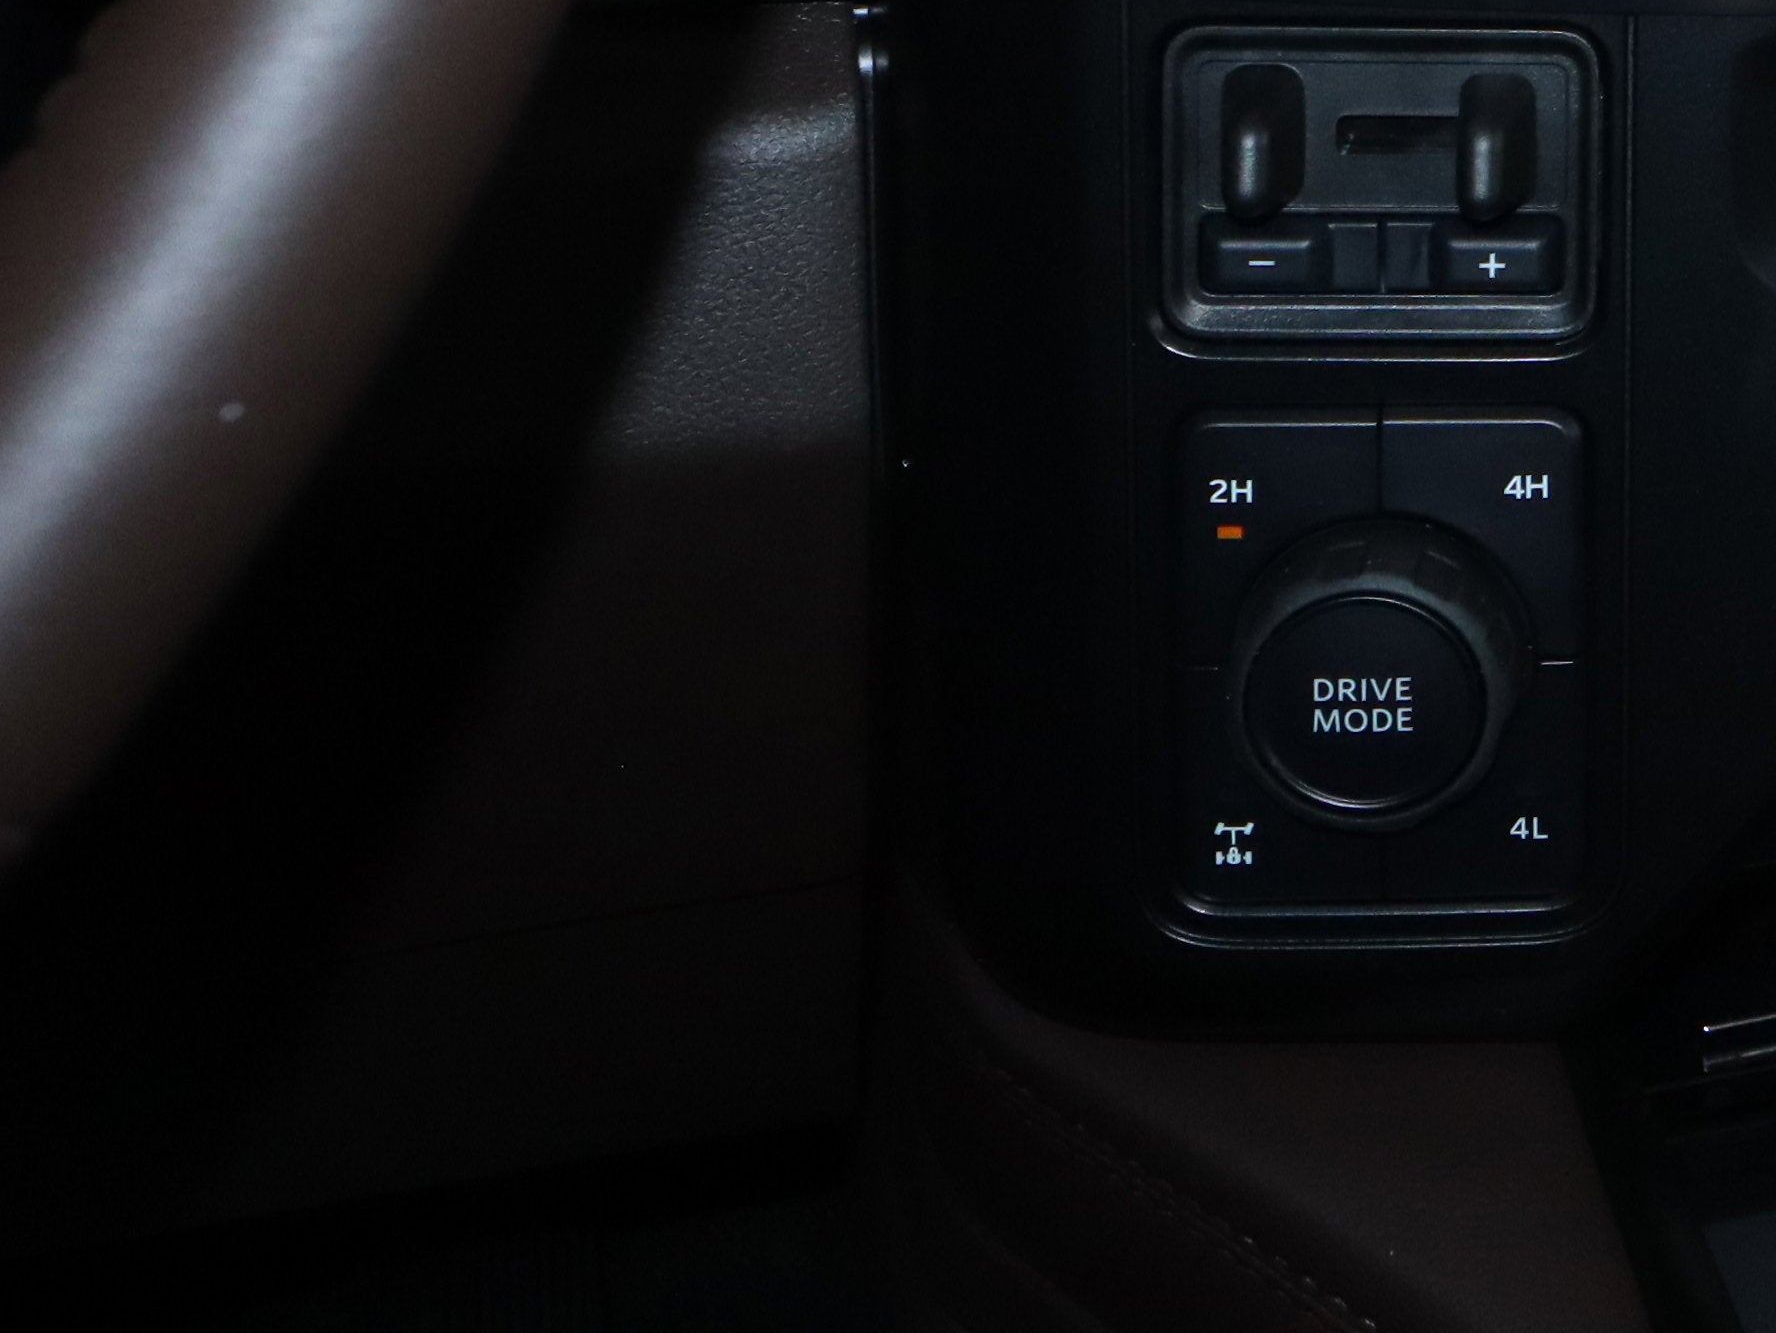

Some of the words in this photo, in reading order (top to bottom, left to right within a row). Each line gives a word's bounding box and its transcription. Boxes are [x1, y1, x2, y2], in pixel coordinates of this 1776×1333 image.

[1209, 479, 1253, 503] 2H
[1504, 474, 1549, 499] 4H
[1313, 677, 1412, 702] DRIVE
[1313, 707, 1413, 733] MODE
[1510, 817, 1548, 840] 4L
